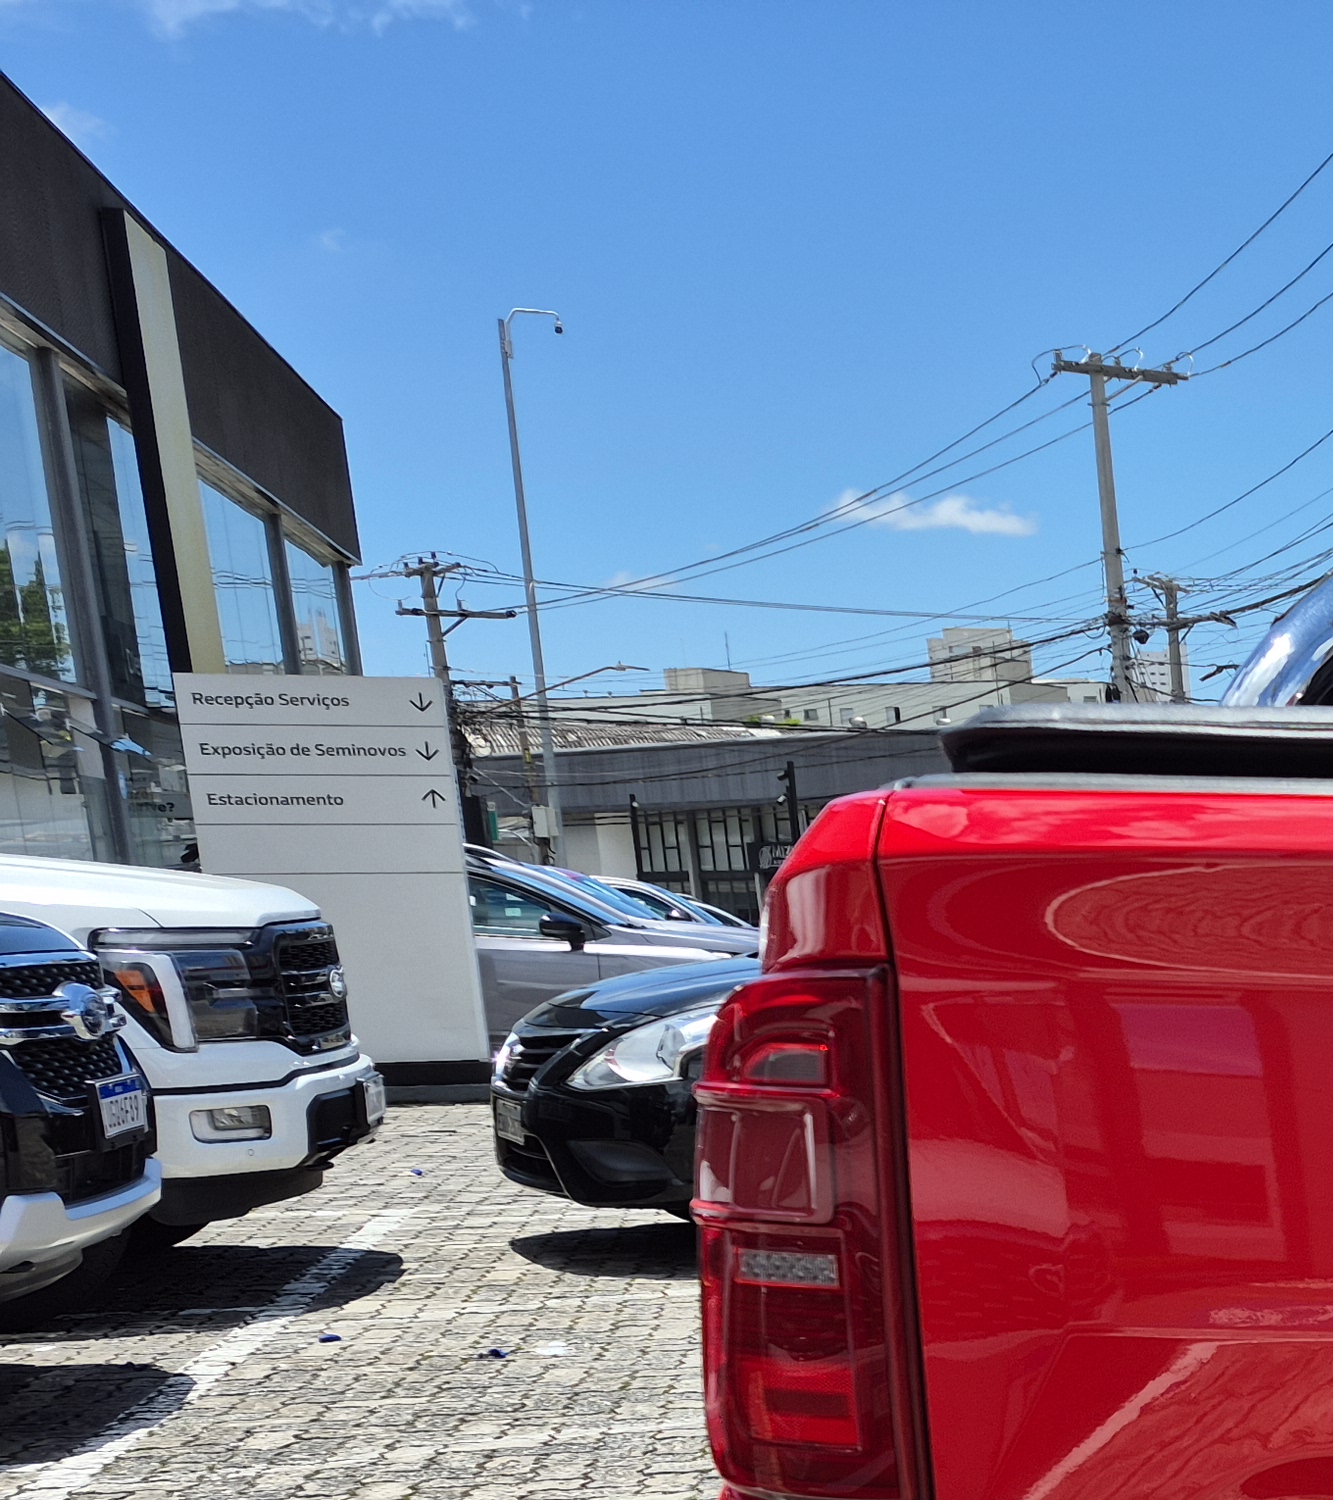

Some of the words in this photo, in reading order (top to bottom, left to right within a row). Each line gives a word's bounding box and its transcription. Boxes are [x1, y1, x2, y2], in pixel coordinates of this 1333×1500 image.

[191, 692, 274, 709] Recepção
[278, 693, 350, 710] Serviços
[199, 742, 286, 759] Exposição
[290, 743, 310, 757] de
[314, 744, 407, 757] Seminovos
[207, 793, 344, 807] Estacionamento
